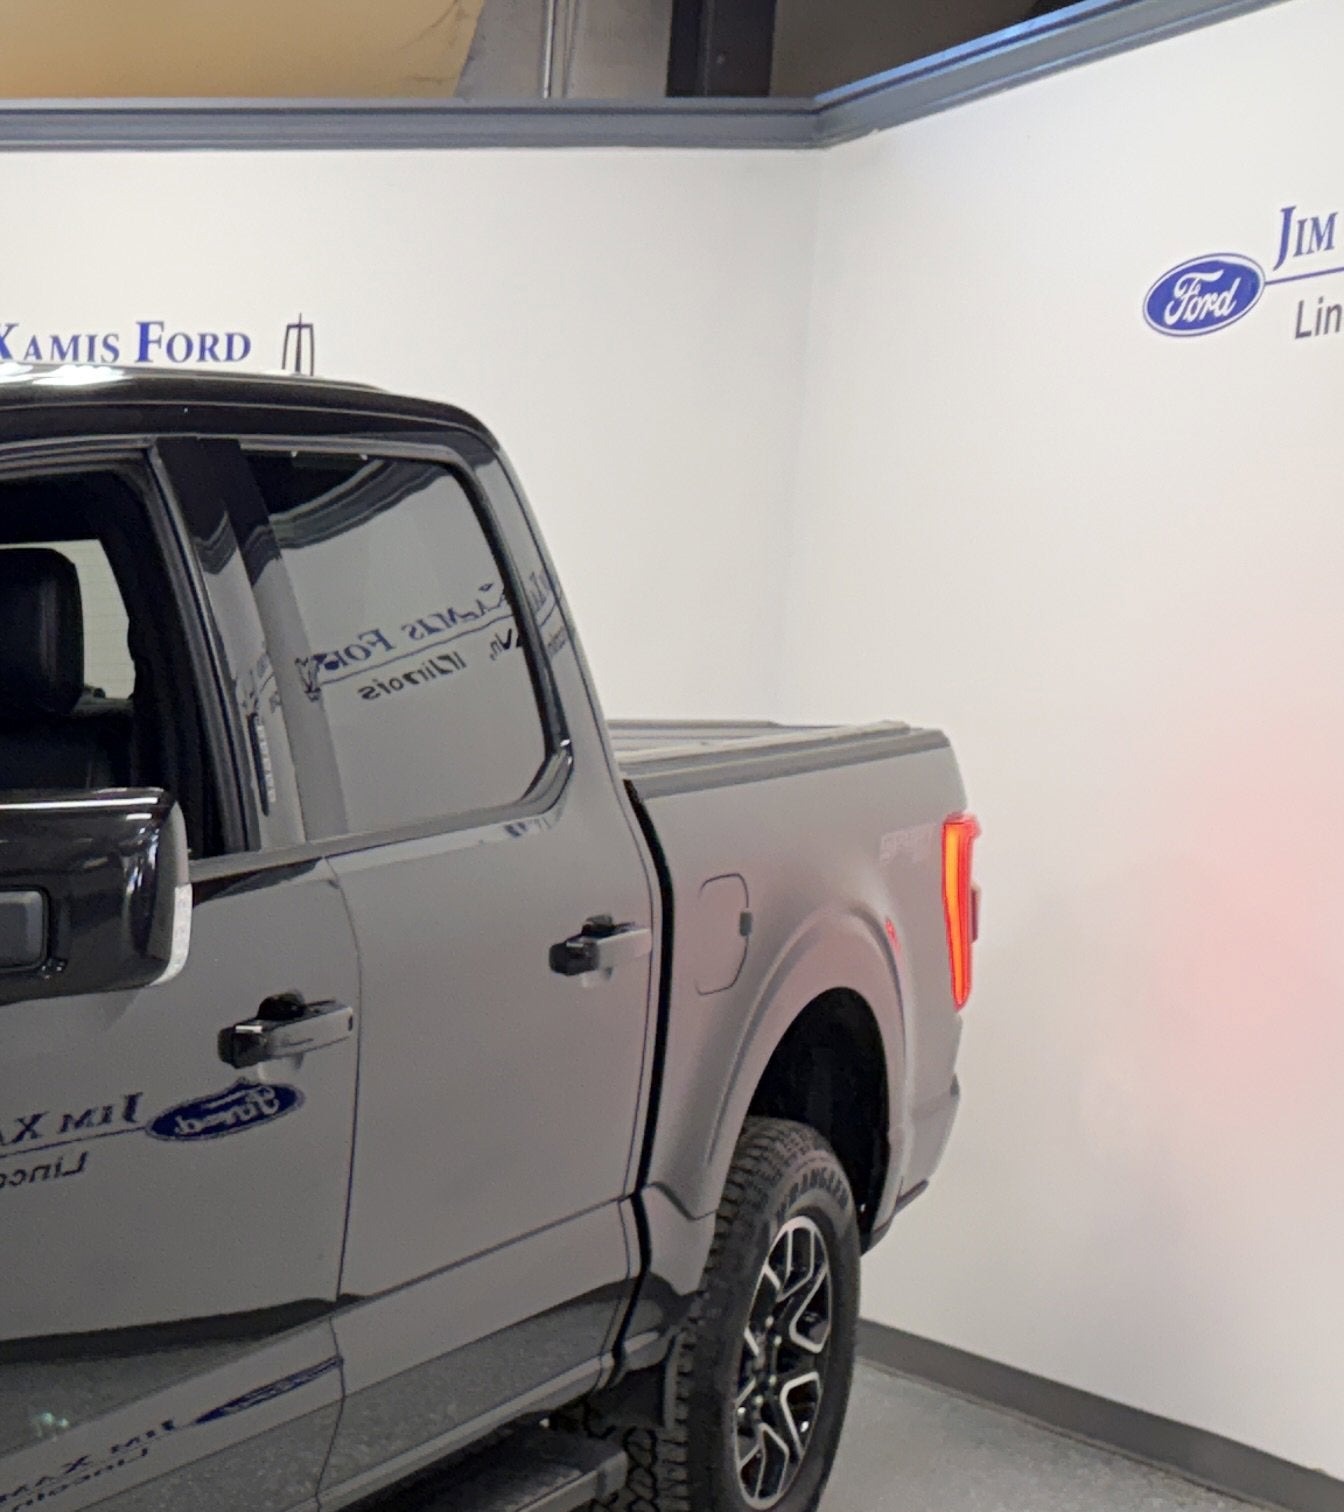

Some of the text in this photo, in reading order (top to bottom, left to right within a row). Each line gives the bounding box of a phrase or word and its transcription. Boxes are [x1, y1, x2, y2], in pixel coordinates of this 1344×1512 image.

[1272, 205, 1338, 271] JIM
[1164, 269, 1242, 326] Ford
[134, 320, 252, 364] FORD
